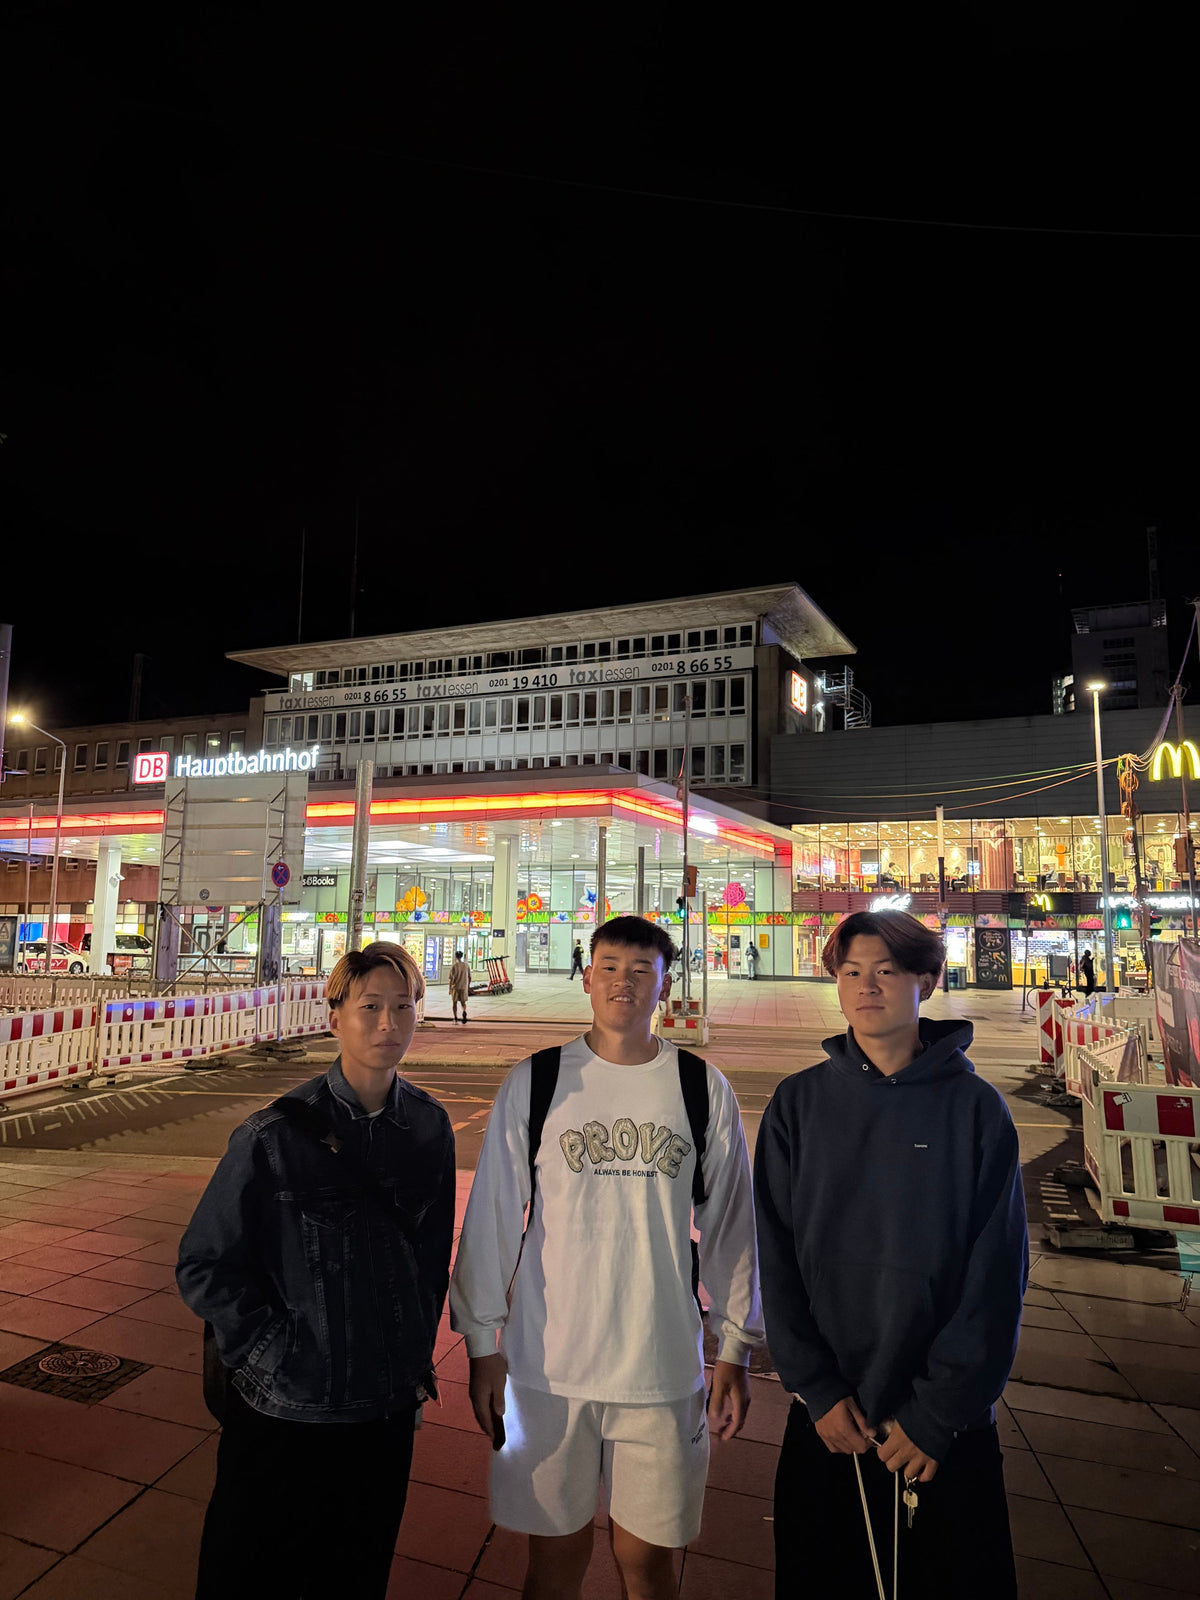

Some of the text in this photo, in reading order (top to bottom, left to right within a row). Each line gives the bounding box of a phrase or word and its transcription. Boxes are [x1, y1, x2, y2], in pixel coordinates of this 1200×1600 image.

[651, 662, 674, 672] 0201
[676, 660, 686, 674] 8
[690, 658, 709, 673] 66
[713, 656, 733, 671] 55
[488, 678, 508, 688] 0201
[512, 676, 528, 690] 19
[531, 673, 557, 688] 410
[344, 691, 362, 701] 0201
[363, 691, 371, 703] 8
[373, 689, 389, 702] 66
[391, 688, 407, 701] 55
[139, 757, 164, 779] DB
[174, 745, 321, 778] Hauptbahnhof
[559, 1118, 691, 1179] PROVE
[593, 1169, 659, 1178] ALWAYS BE HONEST
